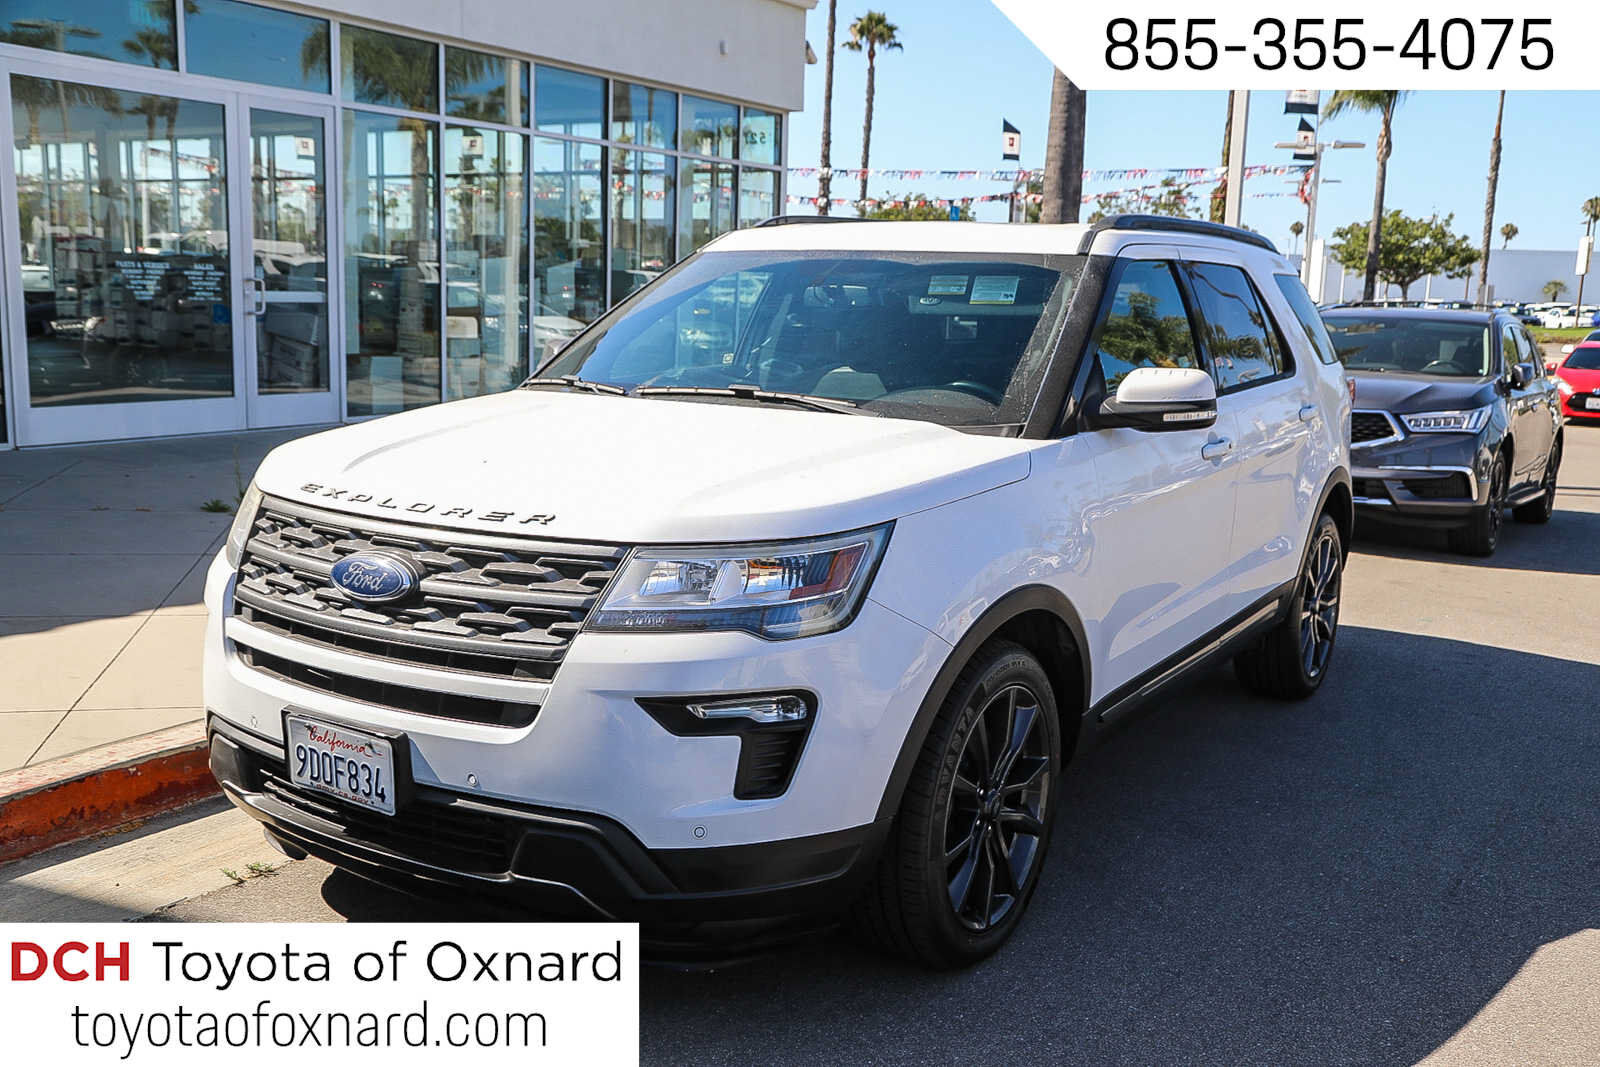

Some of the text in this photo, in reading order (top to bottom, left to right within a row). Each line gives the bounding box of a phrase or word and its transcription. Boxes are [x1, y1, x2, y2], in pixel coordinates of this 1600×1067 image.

[300, 482, 557, 525] EXPLORER
[341, 562, 388, 591] Ford
[309, 725, 373, 758] California
